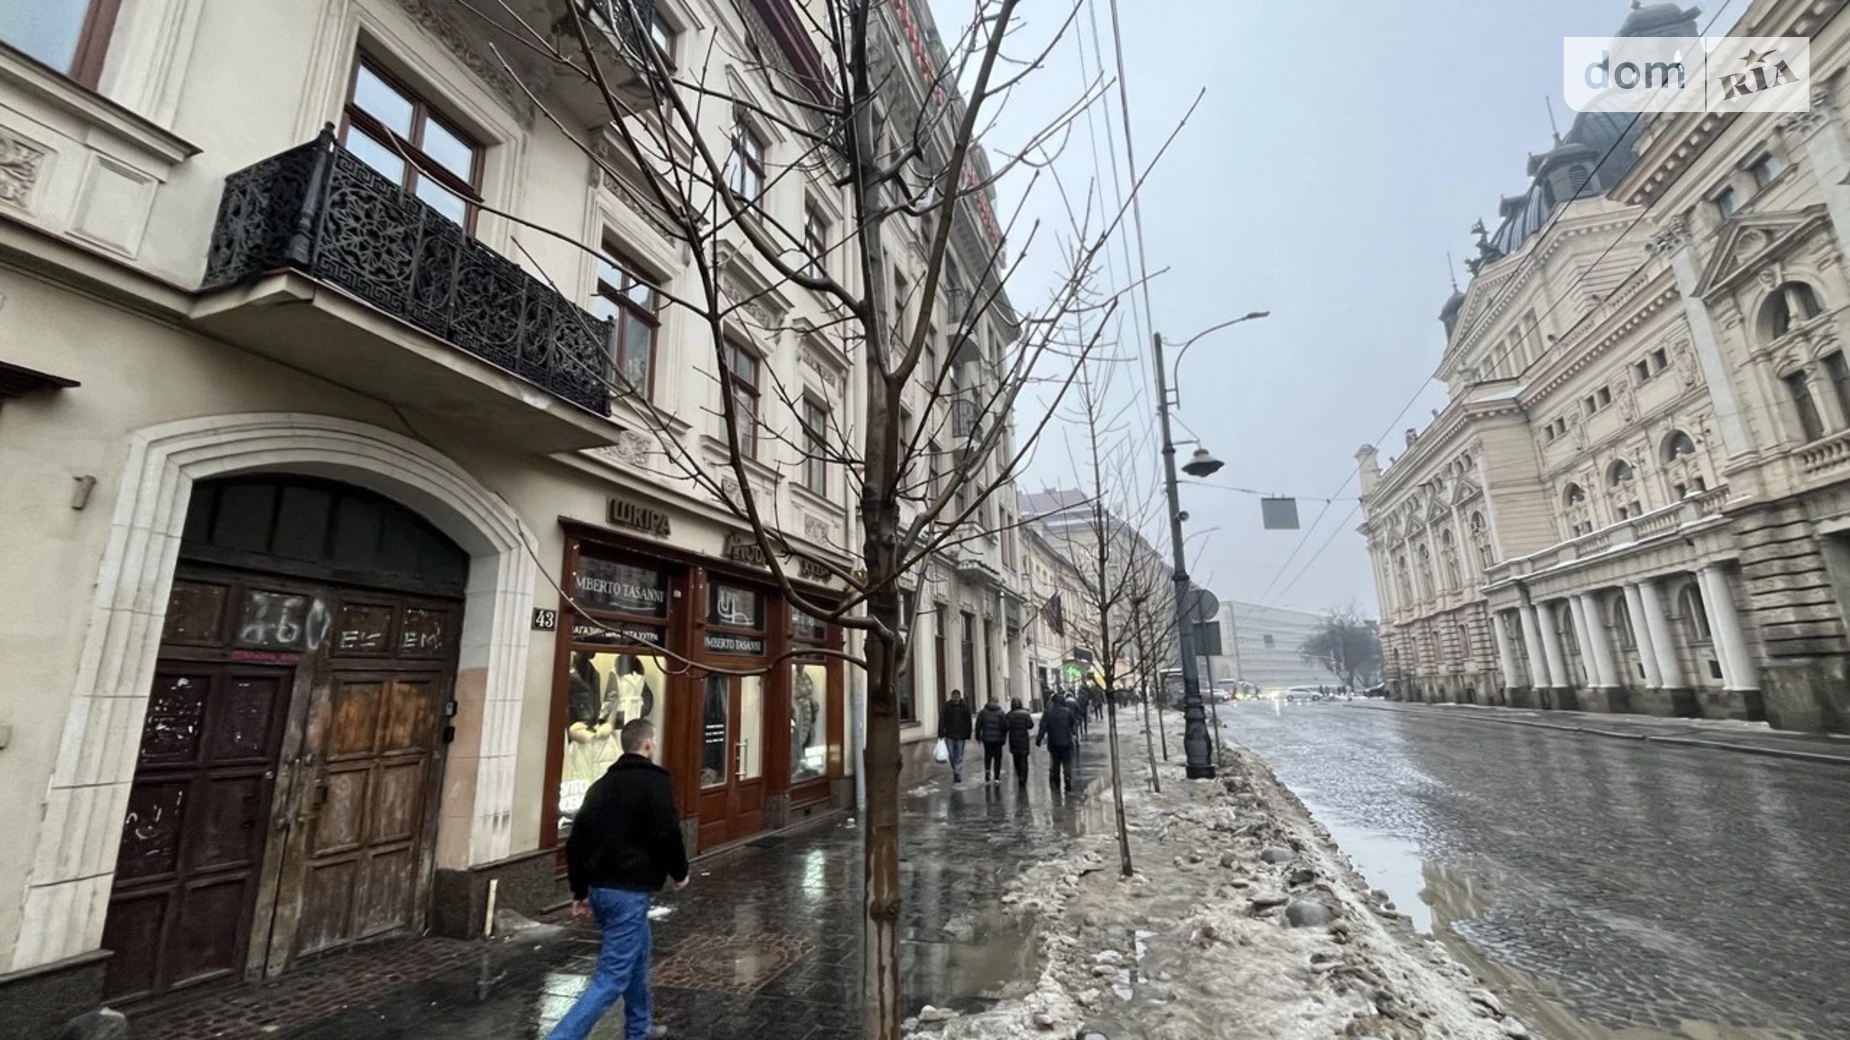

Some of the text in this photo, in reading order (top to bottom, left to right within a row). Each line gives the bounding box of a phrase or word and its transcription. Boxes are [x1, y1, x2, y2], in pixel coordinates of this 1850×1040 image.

[606, 497, 671, 536] ШКІРА
[576, 576, 664, 603] MBERTO TASANNI
[535, 610, 554, 628] 43
[703, 636, 734, 650] MBERTO
